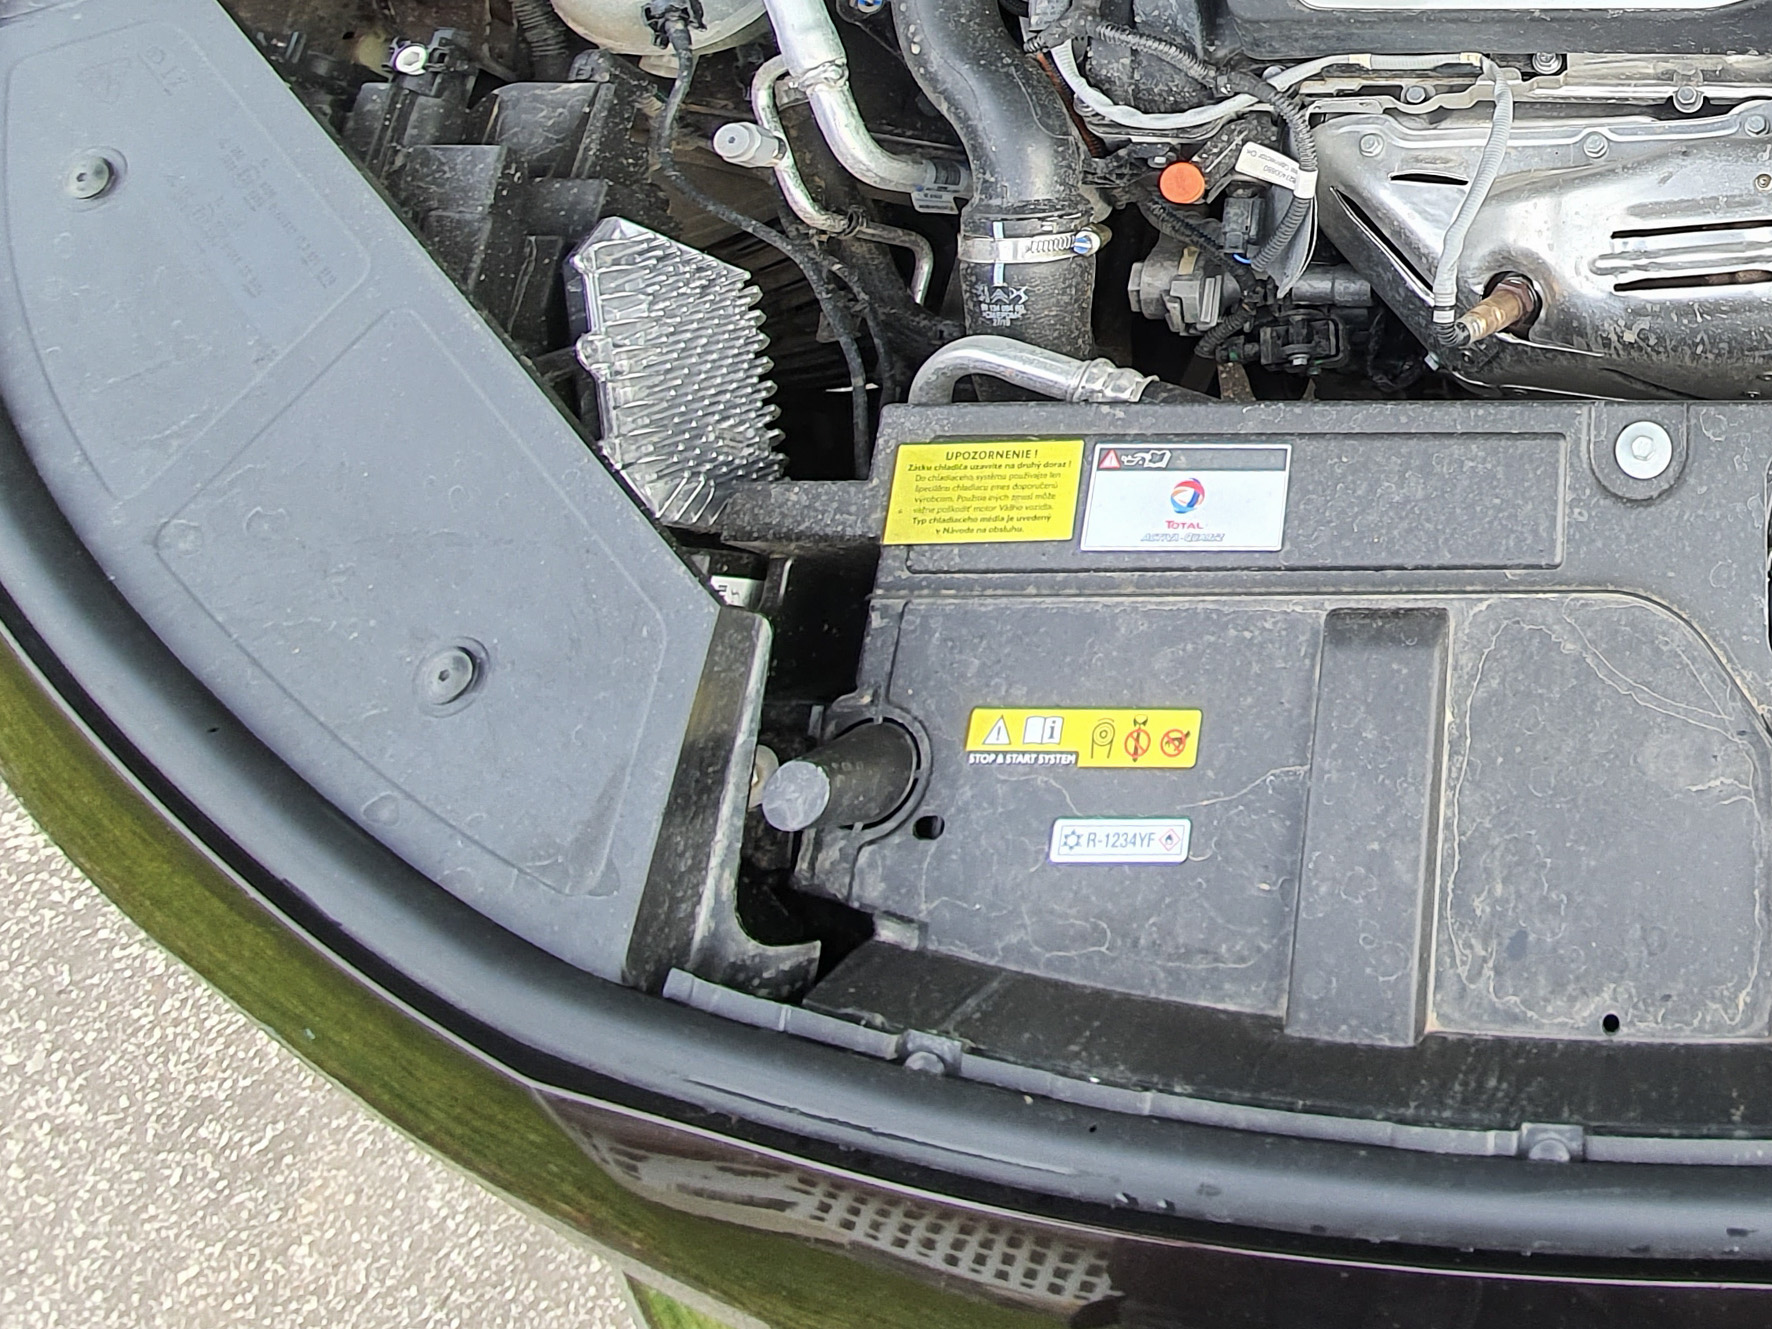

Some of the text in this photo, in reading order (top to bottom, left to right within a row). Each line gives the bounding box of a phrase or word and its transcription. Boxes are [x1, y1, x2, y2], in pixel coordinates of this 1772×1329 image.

[946, 449, 1038, 460] UPOZORNENIE !
[969, 753, 996, 765] STOP
[1005, 753, 1037, 765] START
[1038, 754, 1076, 765] SYSTEM
[1086, 832, 1156, 848] R-1234YF
